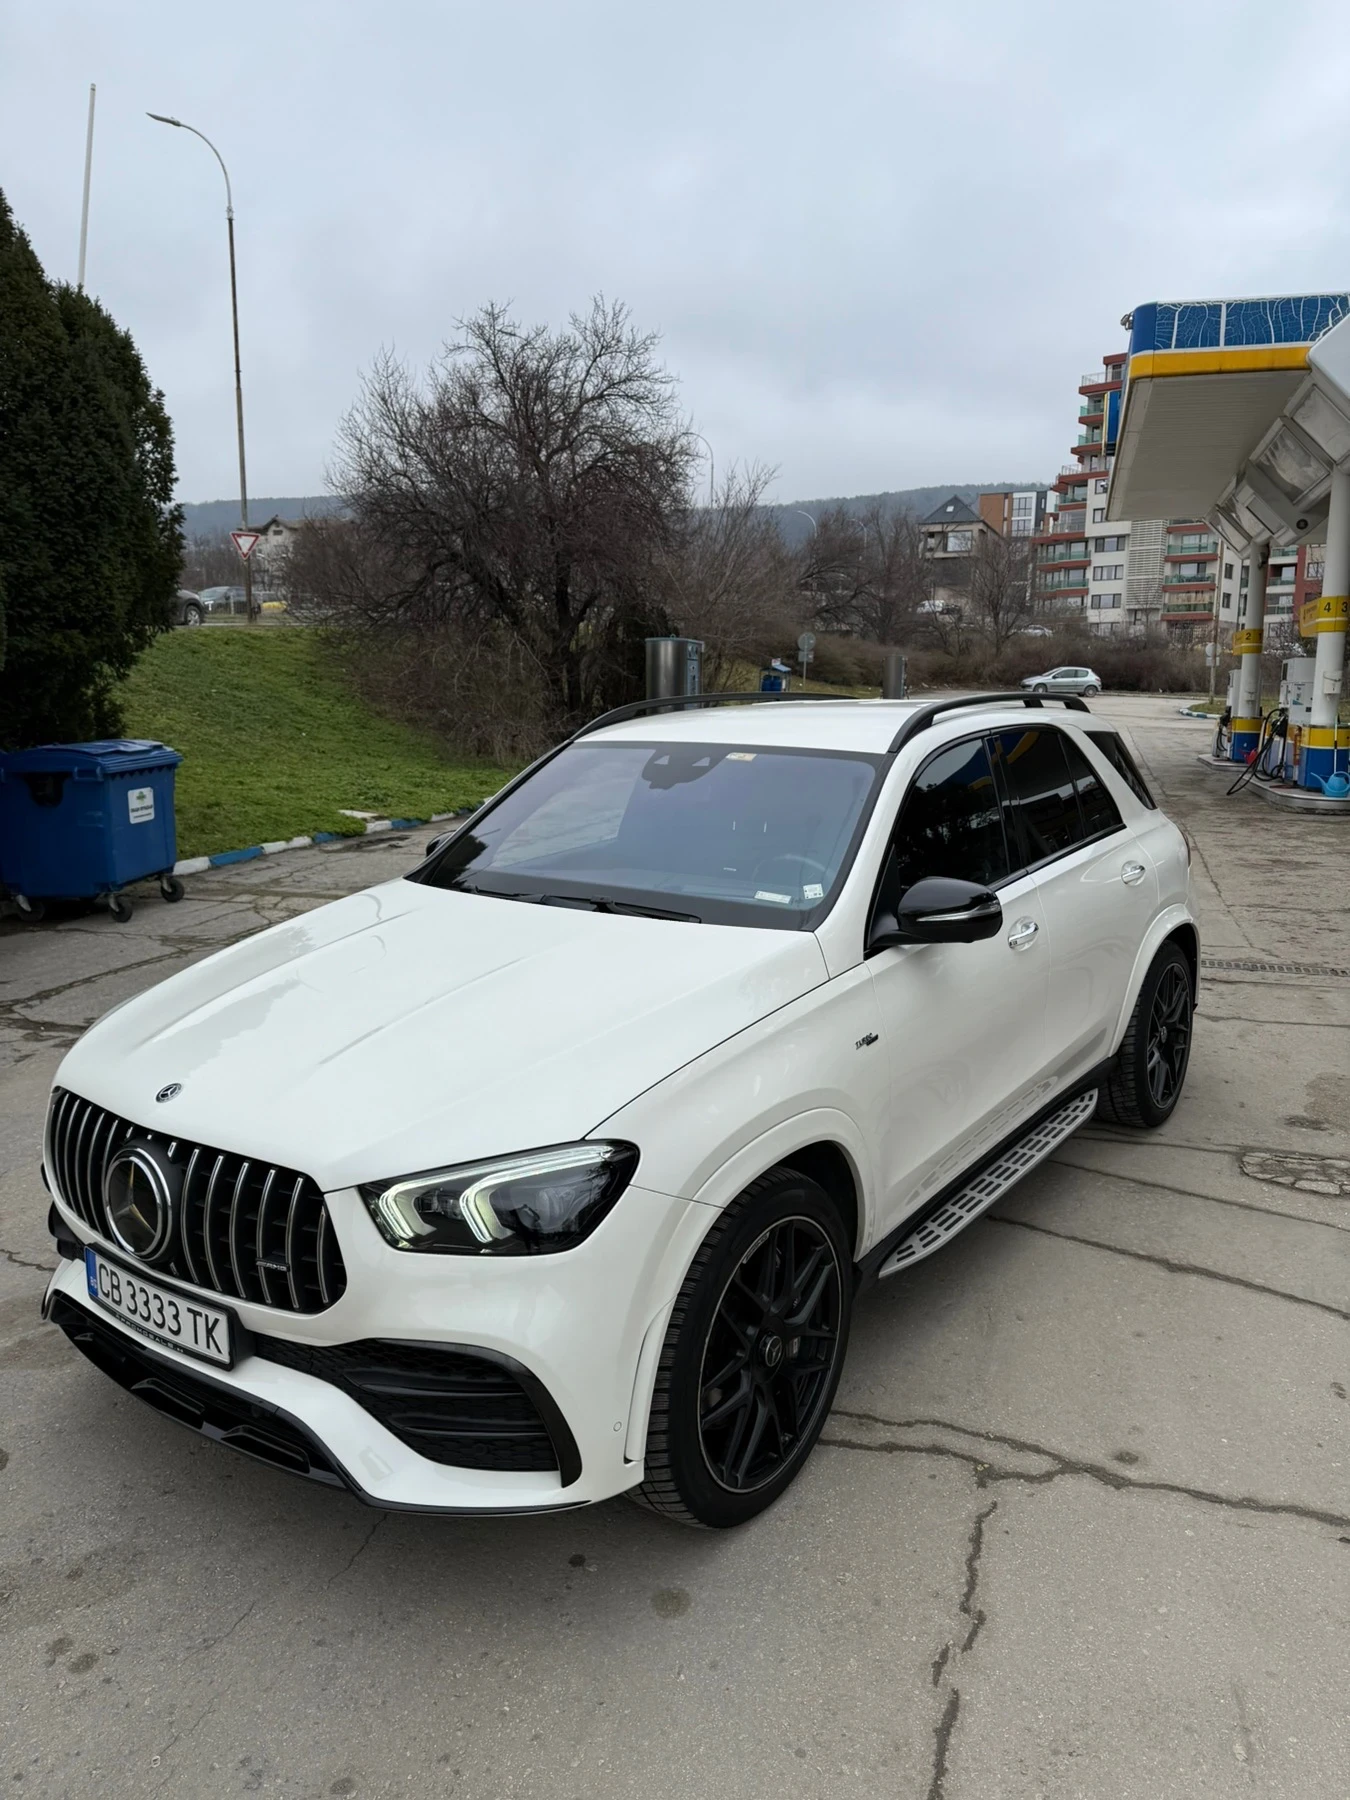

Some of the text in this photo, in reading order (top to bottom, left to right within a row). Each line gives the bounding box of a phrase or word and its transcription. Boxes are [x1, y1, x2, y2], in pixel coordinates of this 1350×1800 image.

[1323, 602, 1332, 613] 4
[1341, 601, 1348, 613] 3
[1245, 632, 1251, 640] 2
[99, 1263, 222, 1354] CB 3333 TK
